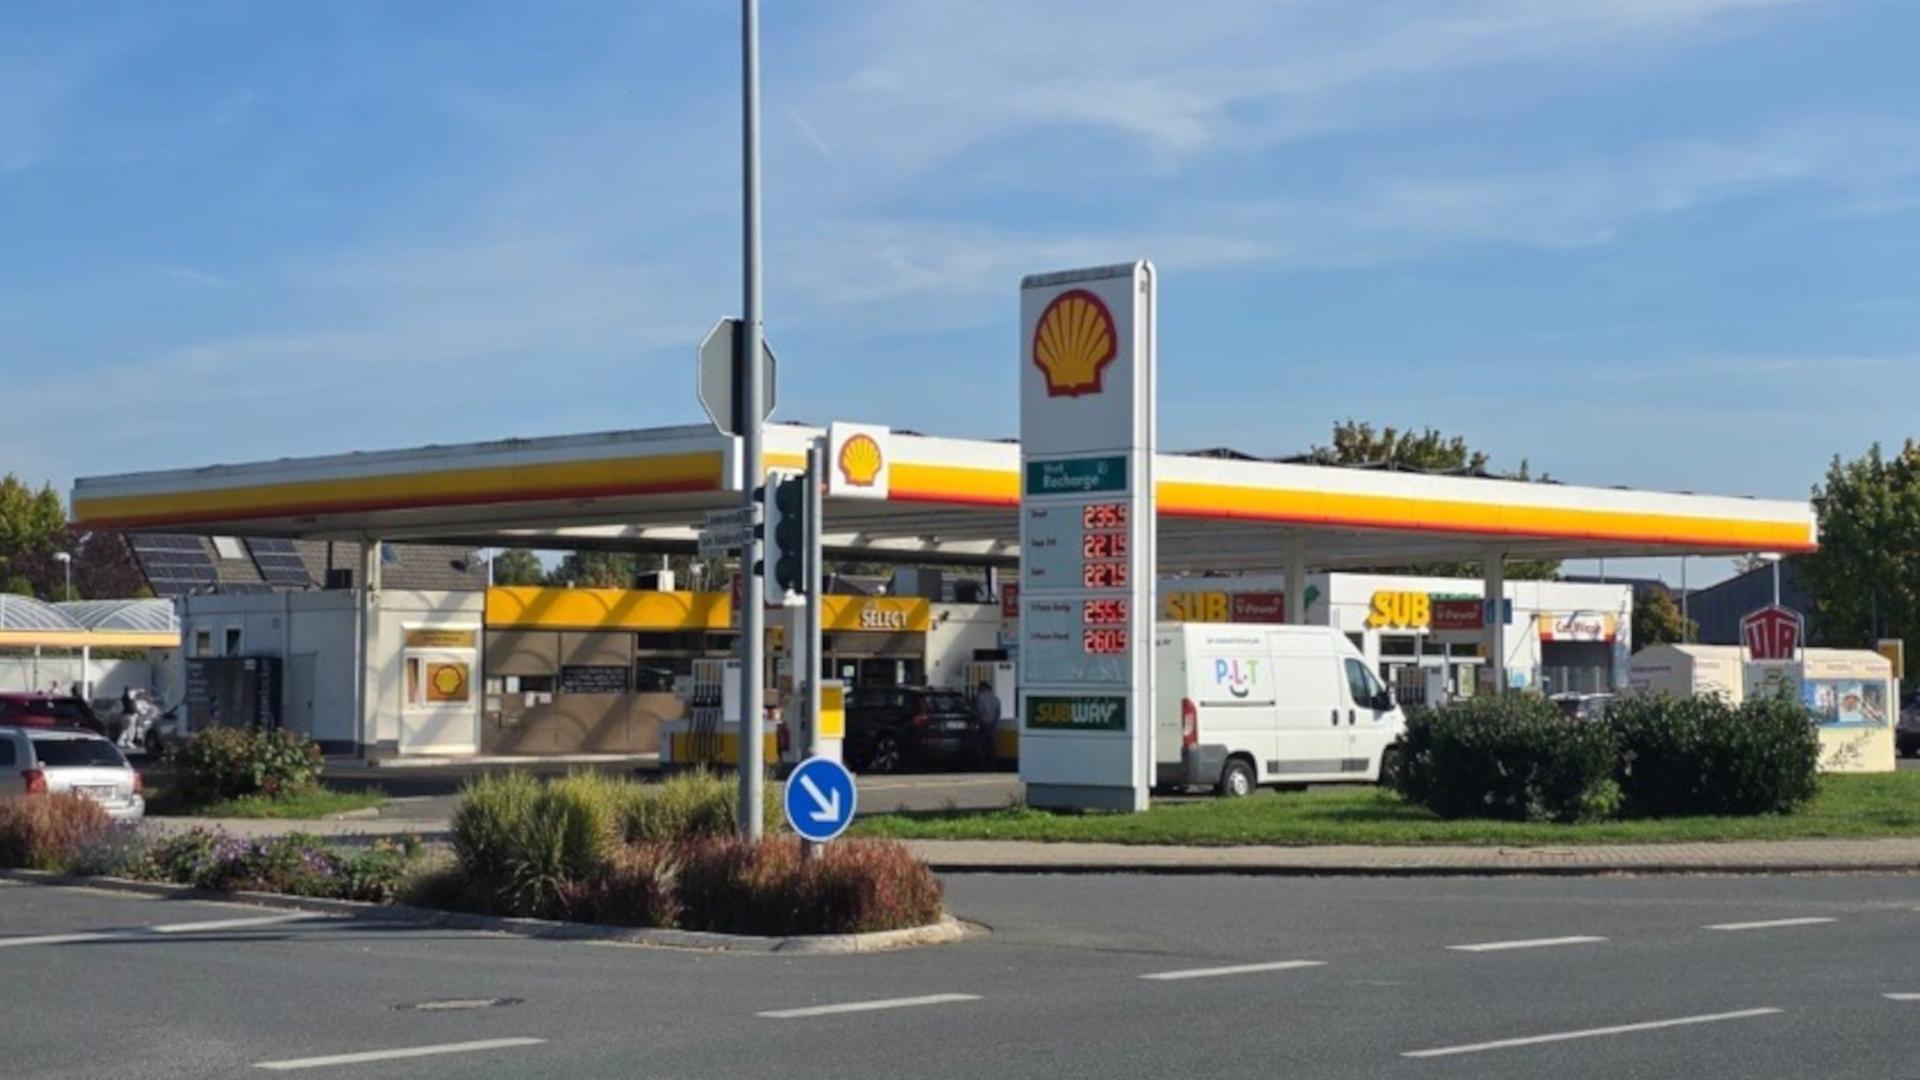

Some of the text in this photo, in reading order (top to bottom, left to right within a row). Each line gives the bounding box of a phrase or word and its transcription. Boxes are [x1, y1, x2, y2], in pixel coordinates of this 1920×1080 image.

[1043, 472, 1100, 490] Recharge
[1165, 591, 1229, 622] SUB
[1365, 590, 1431, 629] SUB
[861, 609, 908, 627] SELECT
[1035, 702, 1118, 724] SUBWAY
